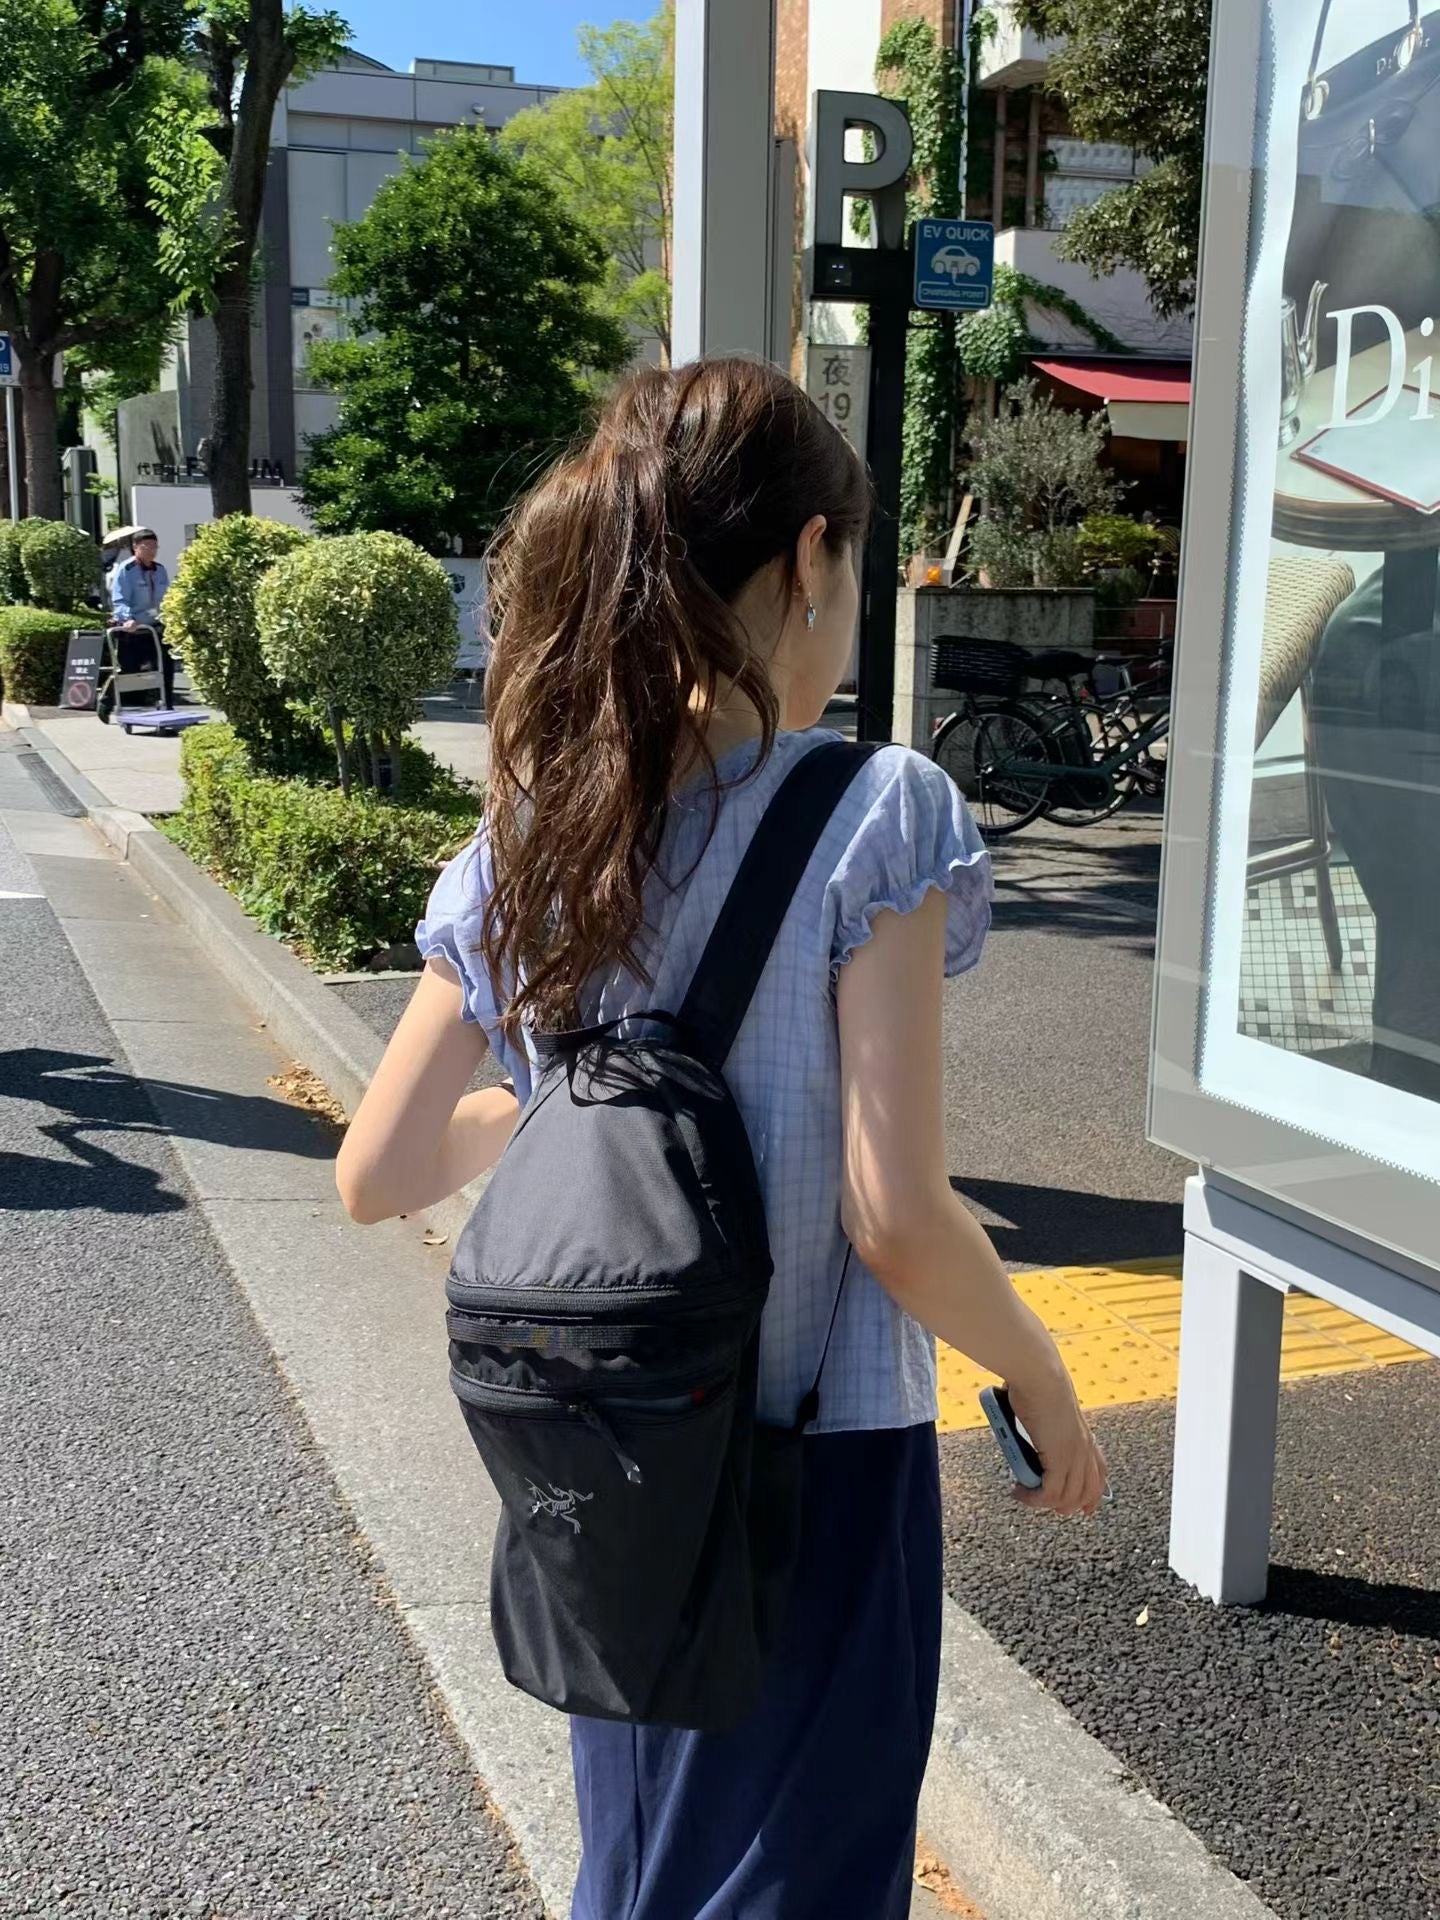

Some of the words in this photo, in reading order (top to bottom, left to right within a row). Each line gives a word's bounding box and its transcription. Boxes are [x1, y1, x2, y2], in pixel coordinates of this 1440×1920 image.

[815, 90, 913, 245] P
[923, 225, 942, 238] EV
[945, 226, 991, 241] QUICK
